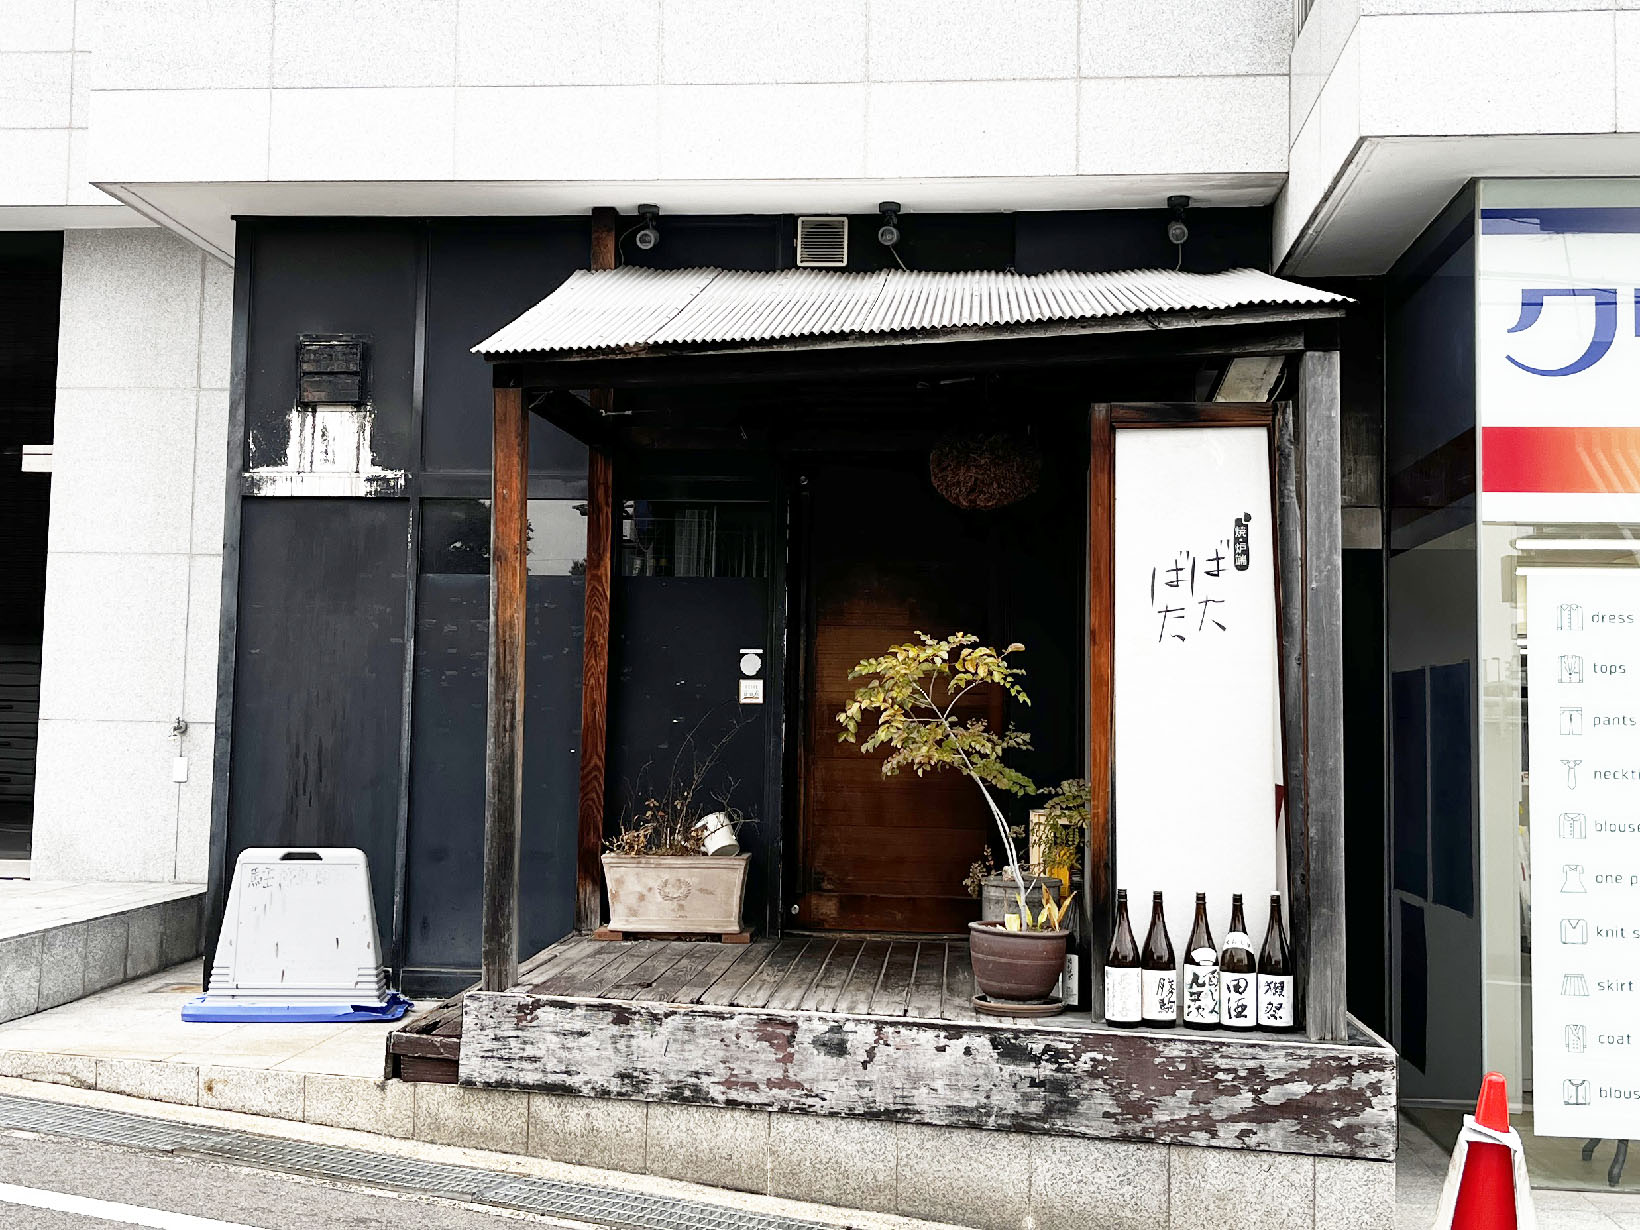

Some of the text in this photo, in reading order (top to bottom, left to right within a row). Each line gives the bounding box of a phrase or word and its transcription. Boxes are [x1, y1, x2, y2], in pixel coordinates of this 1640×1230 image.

[1505, 287, 1640, 378] ク
[1591, 611, 1634, 624] dress
[1593, 662, 1626, 675] tops
[1593, 713, 1637, 728] pants
[1595, 874, 1623, 884] one
[1596, 924, 1626, 939] knit
[1597, 978, 1634, 992] skirt
[1598, 1033, 1632, 1045] coat
